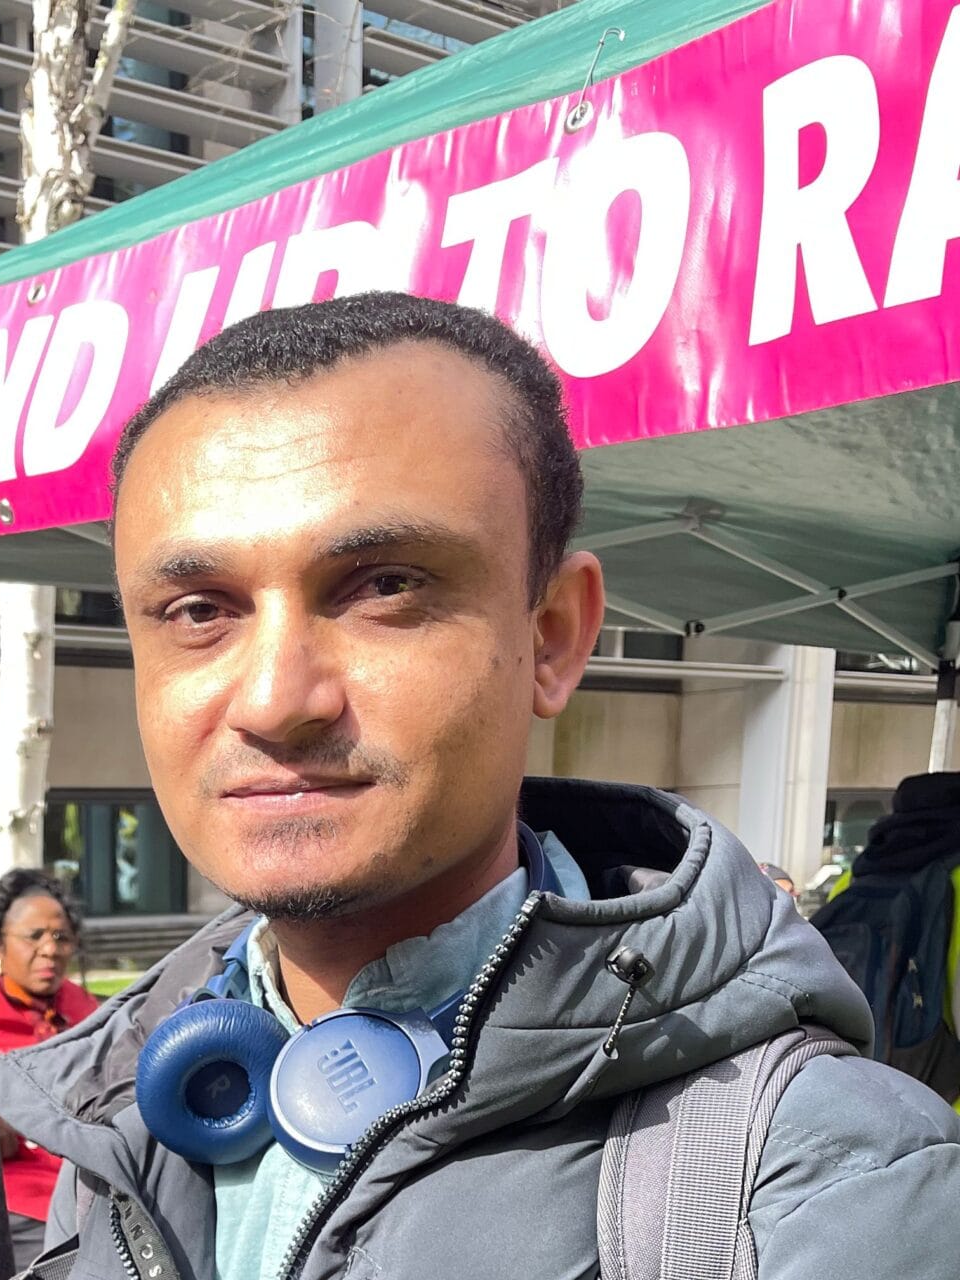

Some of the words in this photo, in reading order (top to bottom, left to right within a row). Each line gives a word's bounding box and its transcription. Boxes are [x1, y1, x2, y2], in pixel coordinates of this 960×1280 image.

[440, 131, 691, 378] TO
[205, 1074, 231, 1099] R
[316, 1039, 378, 1115] JBL
